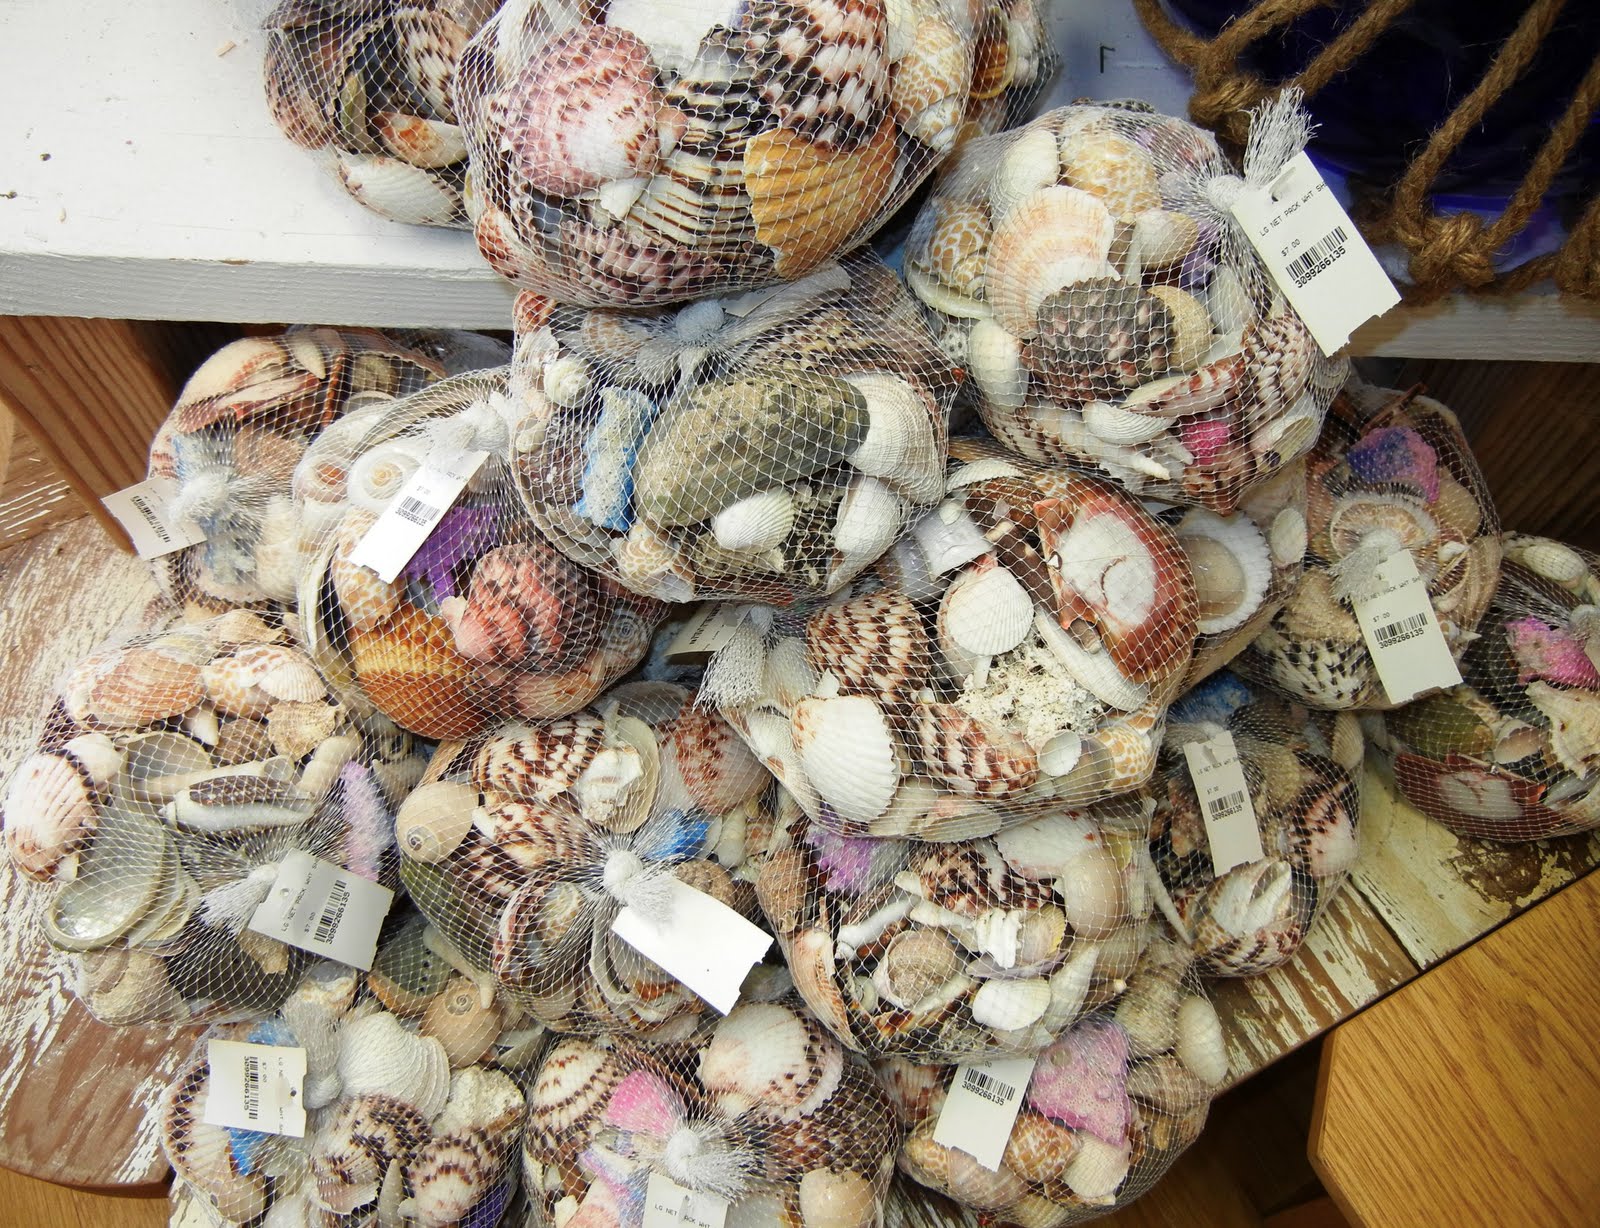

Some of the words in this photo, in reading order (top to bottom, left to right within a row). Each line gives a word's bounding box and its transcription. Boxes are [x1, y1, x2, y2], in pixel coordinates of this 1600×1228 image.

[1260, 226, 1270, 237] LG
[1270, 215, 1283, 228] NET
[1284, 201, 1300, 216] PACK
[1301, 190, 1314, 204] WHT
[1281, 238, 1301, 257] $7.00
[1294, 245, 1346, 289] 3099266135
[1378, 628, 1425, 649] 3099266135
[281, 922, 290, 932] LG
[287, 908, 297, 920] NET
[296, 888, 307, 905] PACK
[304, 872, 313, 886] WHT
[326, 891, 351, 945] 3099266135
[962, 1080, 1005, 1106] 3099266135
[666, 1208, 678, 1216] NET
[684, 1214, 696, 1224] ACK
